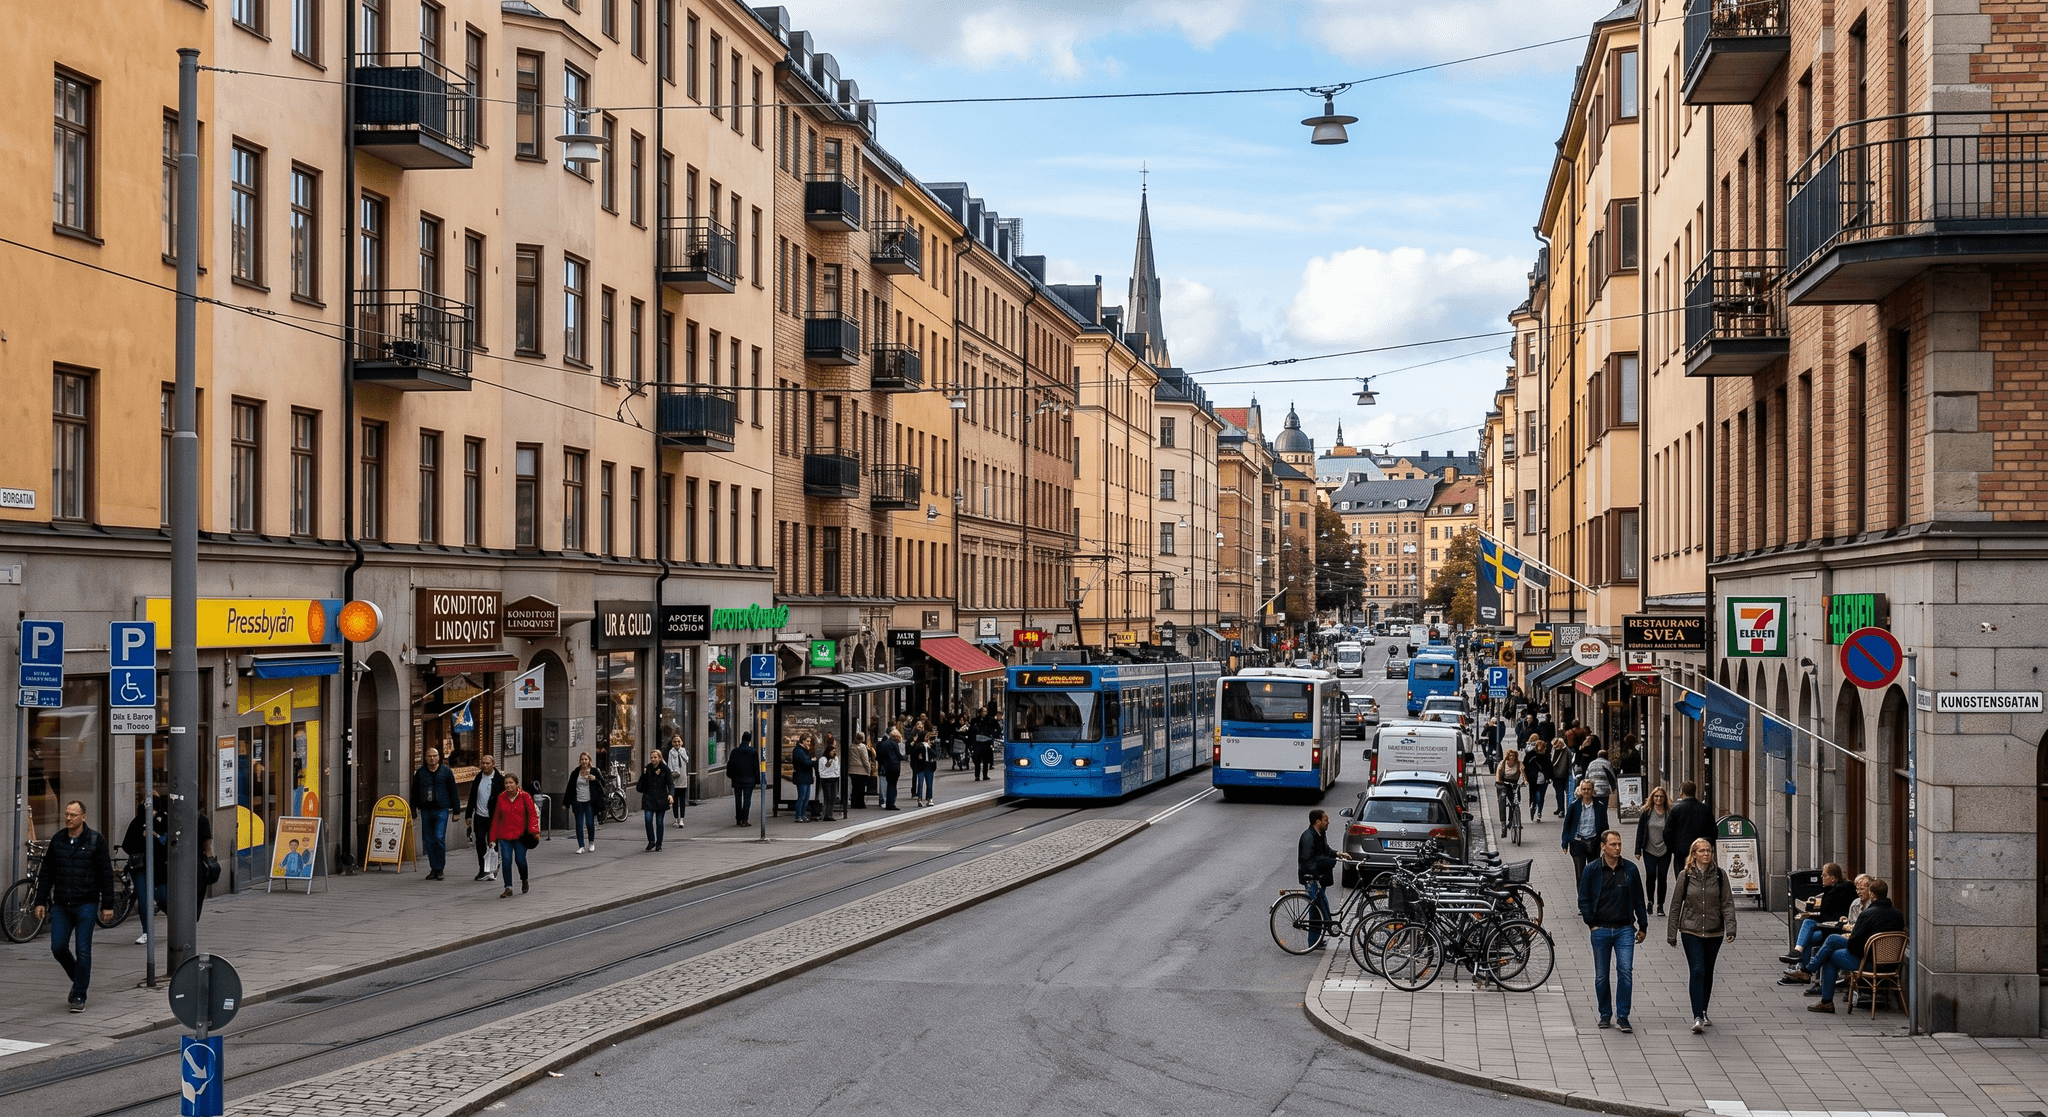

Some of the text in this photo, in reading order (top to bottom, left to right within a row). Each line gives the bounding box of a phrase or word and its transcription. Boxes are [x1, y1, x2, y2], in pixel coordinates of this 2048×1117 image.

[433, 594, 497, 615] KONDITORI
[507, 610, 555, 619] KONDITORI
[668, 614, 704, 623] APOTEK
[226, 606, 294, 641] Pressbyrån
[507, 620, 555, 628] LINDQVIST
[604, 613, 652, 637] UR & GULD
[1629, 619, 1700, 628] RESTAURANG
[435, 620, 496, 643] LINDQVIST
[1643, 629, 1685, 641] SVEA
[1739, 629, 1775, 638] ELEVEN
[32, 626, 55, 659] P
[122, 628, 146, 661] P
[1023, 673, 1031, 685] 7
[1493, 670, 1503, 684] P
[1264, 683, 1272, 692] 4
[1941, 696, 2039, 708] KUNGSTENSGATAN
